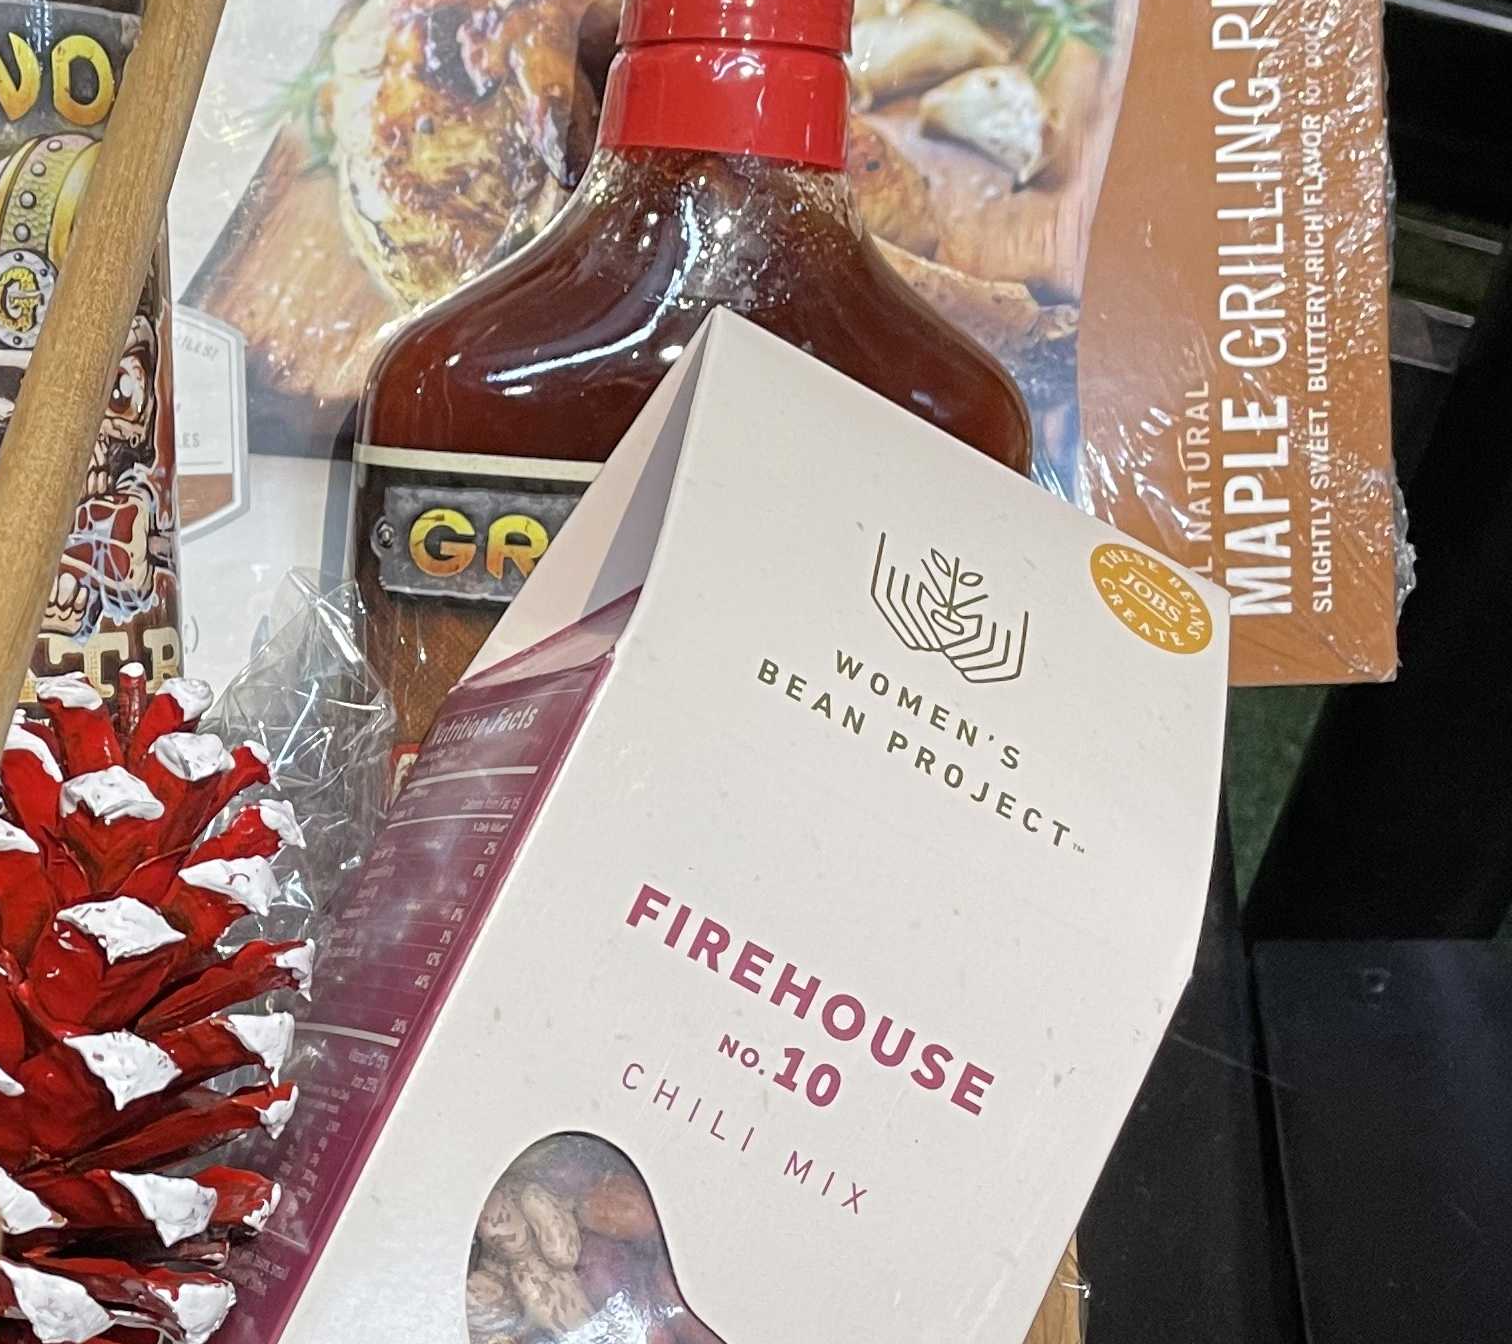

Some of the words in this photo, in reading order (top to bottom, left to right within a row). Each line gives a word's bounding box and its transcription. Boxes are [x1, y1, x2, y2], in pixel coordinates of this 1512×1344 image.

[1213, 78, 1288, 368] GRILLING
[1301, 113, 1324, 207] FLAVOR
[1304, 211, 1329, 393] BUTTERY-RICH
[1184, 381, 1213, 542] NATURAL
[1221, 396, 1293, 616] MAPLE
[1310, 400, 1332, 494] SWEET,
[1098, 548, 1160, 574] THESE
[1167, 575, 1206, 641] BEANS
[1100, 576, 1185, 646] CREATE
[1119, 572, 1183, 623] JOBS
[1312, 498, 1334, 613] SLIGHTLY
[756, 657, 866, 735] BEAN
[885, 729, 1071, 847] PROJECT
[835, 648, 1020, 770] WOMEN'S
[624, 882, 995, 1116] FIREHOUSE
[621, 1062, 755, 1152] CHILI
[782, 1149, 868, 1215] MIX
